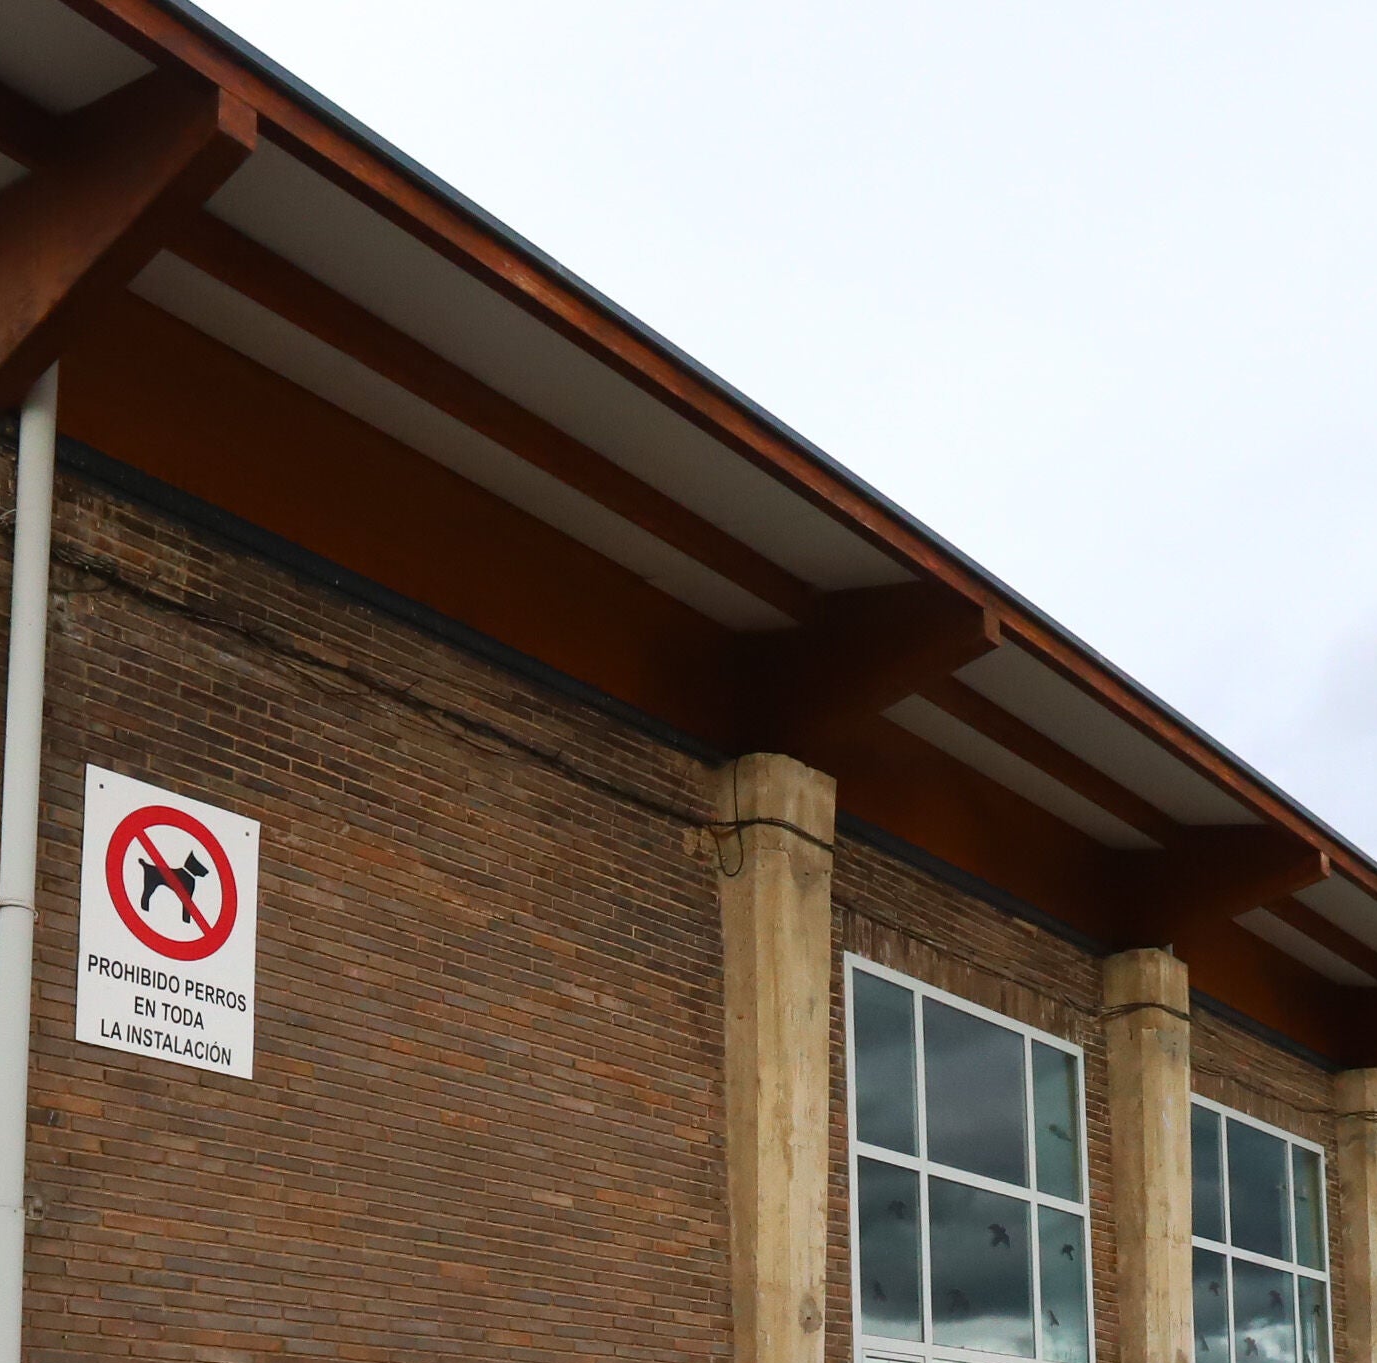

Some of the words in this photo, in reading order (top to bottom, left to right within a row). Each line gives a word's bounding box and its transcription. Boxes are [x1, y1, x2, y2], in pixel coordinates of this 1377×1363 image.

[88, 954, 180, 993] PROHIBIDO
[185, 979, 247, 1012] PERROS
[134, 996, 156, 1018] EN
[162, 1002, 205, 1030] TODA
[101, 1018, 122, 1041] LA
[126, 1024, 232, 1066] INSTALACIÓN
